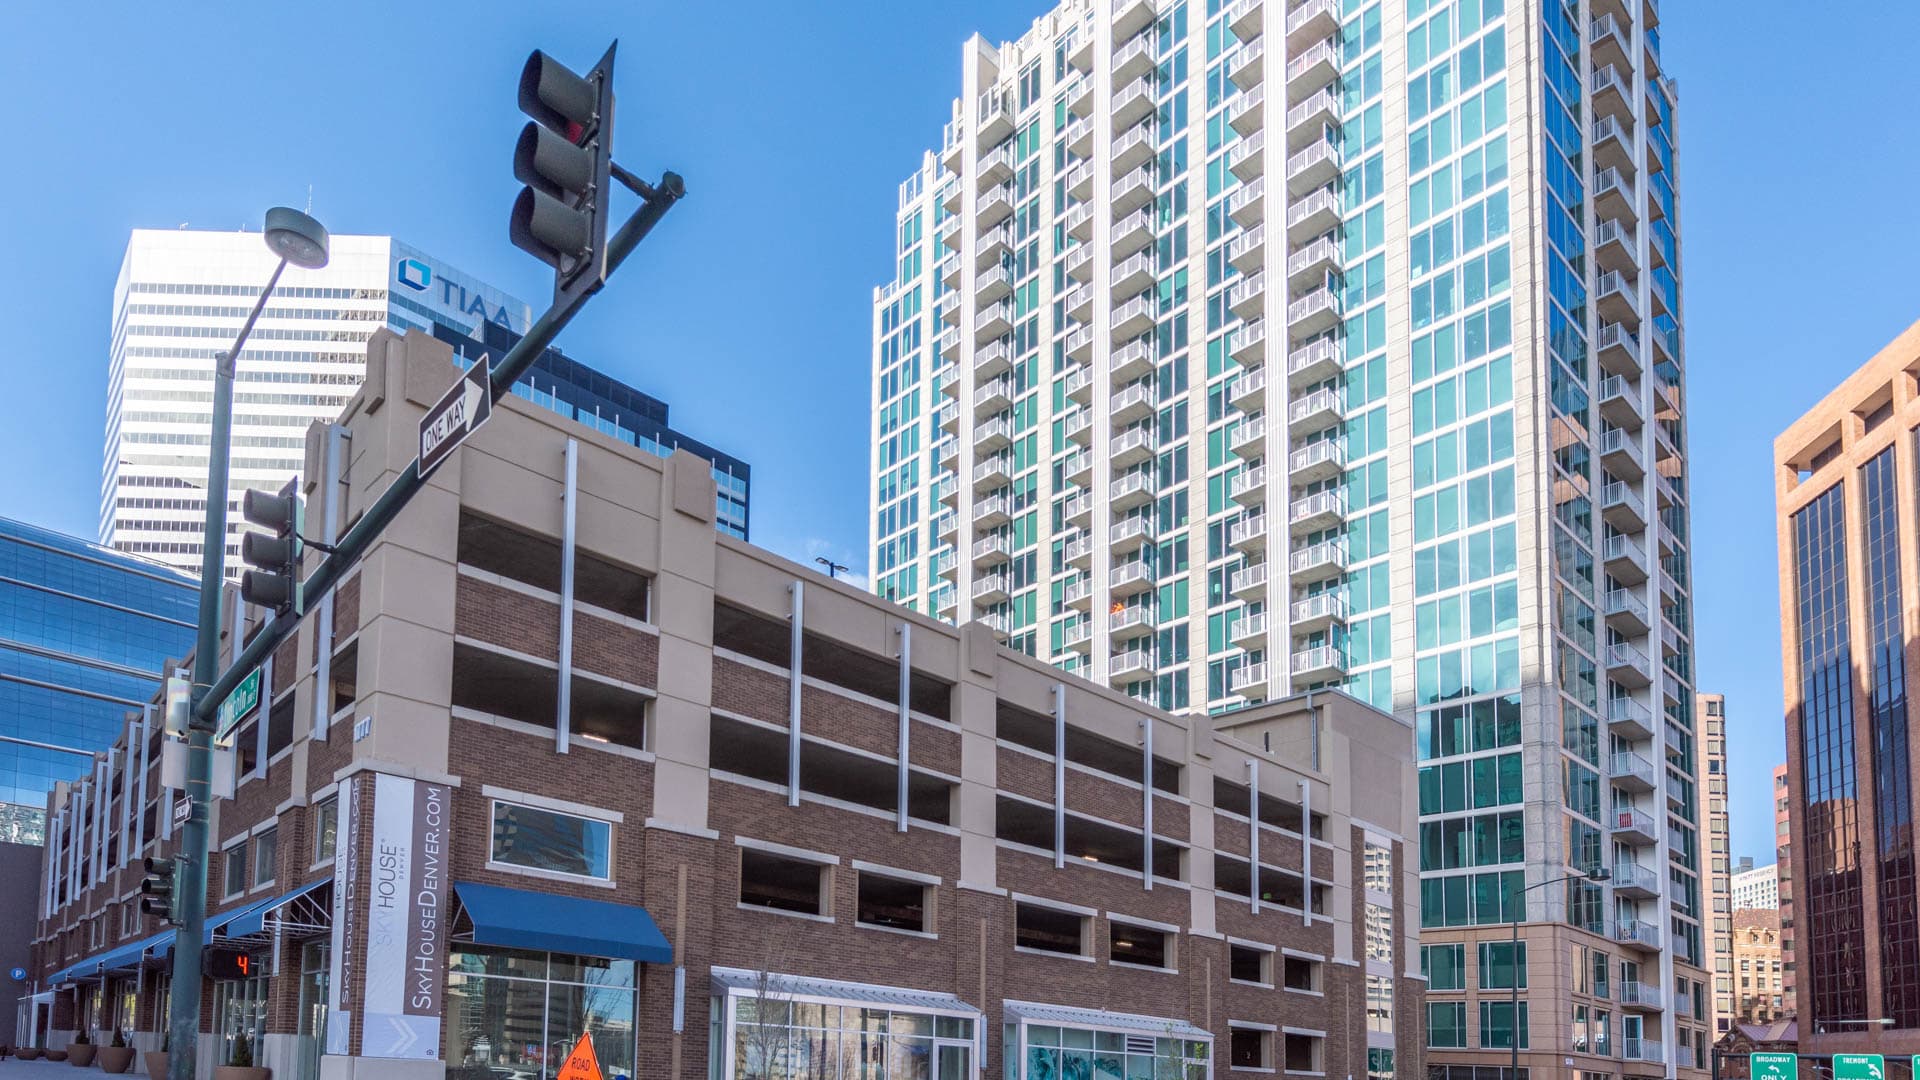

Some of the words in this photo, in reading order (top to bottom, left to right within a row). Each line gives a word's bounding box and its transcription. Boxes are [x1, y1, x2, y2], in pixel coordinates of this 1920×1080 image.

[433, 274, 512, 330] TIAA
[426, 418, 443, 452] ONE
[446, 398, 467, 433] WAY
[412, 787, 441, 1010] SKYHOUSEDENVER.COM
[238, 955, 248, 975] 4
[572, 1056, 590, 1071] ROAD
